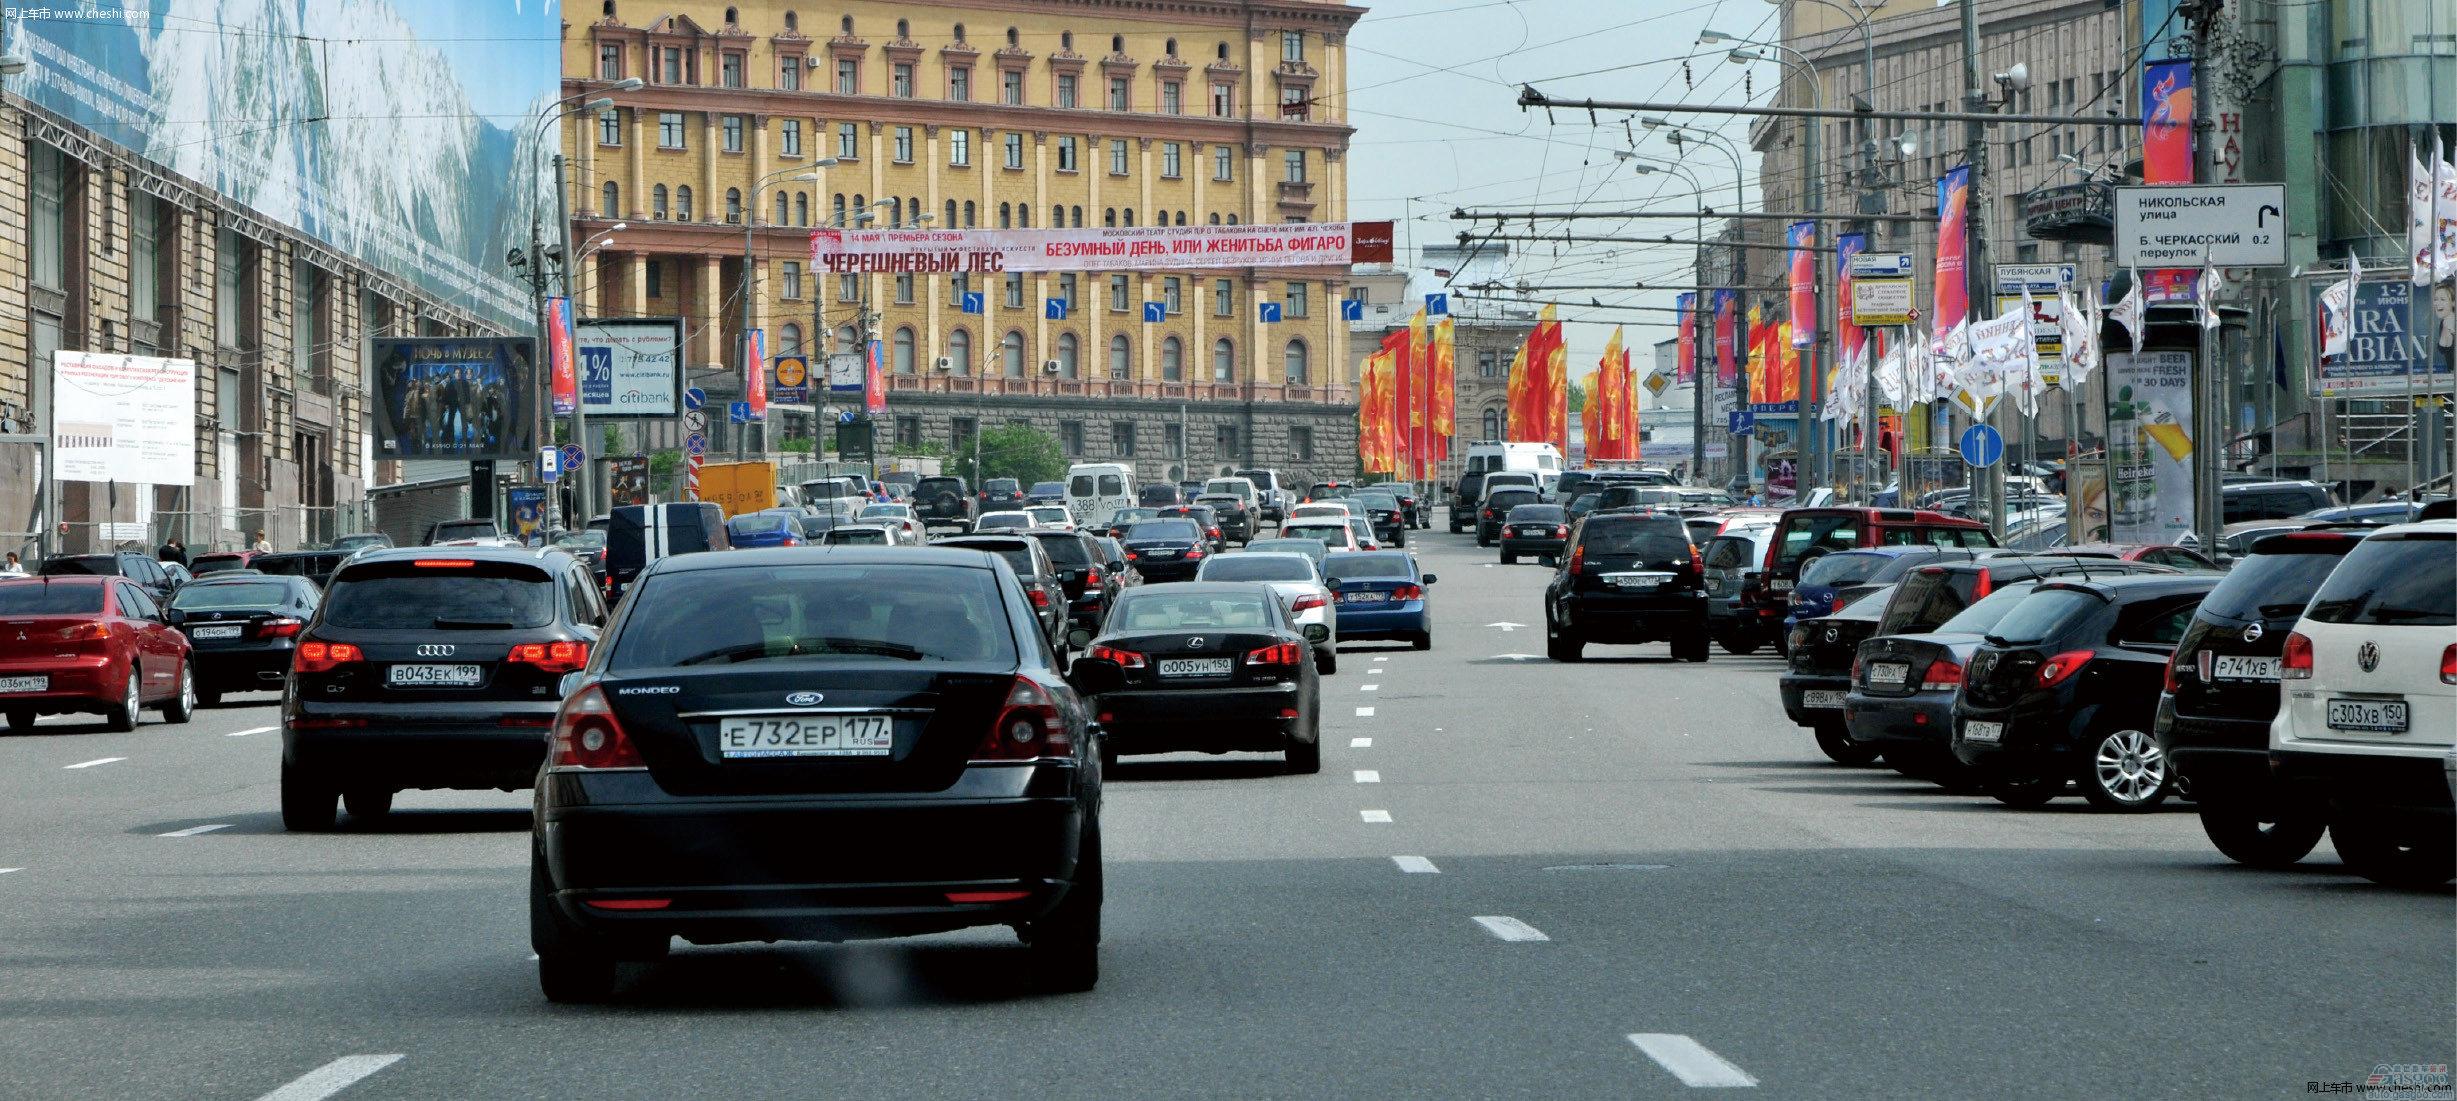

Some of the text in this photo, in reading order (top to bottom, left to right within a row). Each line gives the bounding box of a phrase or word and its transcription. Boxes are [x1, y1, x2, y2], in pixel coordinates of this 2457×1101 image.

[2139, 196, 2225, 208] НИКОЛЬСКАЯ
[2140, 210, 2177, 222] улица
[862, 233, 880, 241] МАЯ
[888, 233, 929, 241] ПРЕМЬЕРА
[932, 232, 964, 241] СЕЗОНА
[2140, 233, 2270, 245] Б. ЧЕРКАССКИЙ 0.2
[1046, 240, 1126, 257] БЕЗУМНЫЙ
[1173, 239, 1202, 254] ИЛИ
[1206, 237, 1284, 253] ЖЕНИТЬБА
[1288, 235, 1345, 251] ФИГАРО
[2140, 249, 2197, 259] переулок
[823, 250, 1004, 273] ЧЕРЕШНЕВЫЙ ЛЕС
[2160, 354, 2186, 364] BEER
[2153, 366, 2186, 375] FRESH
[2144, 378, 2157, 387] 30
[2160, 378, 2186, 387] DAYS
[620, 391, 670, 404] citibank
[1163, 659, 1228, 673] О005УН 150
[2217, 658, 2267, 675] Р741ХВ
[395, 666, 477, 681] В043ЕК 199
[33, 677, 46, 686] 199
[619, 686, 680, 695] MONDEO
[794, 694, 816, 703] Ford
[2332, 704, 2402, 724] С303ХВ 150
[730, 718, 885, 747] Е732ЕР 177
[852, 738, 874, 746] RUS
